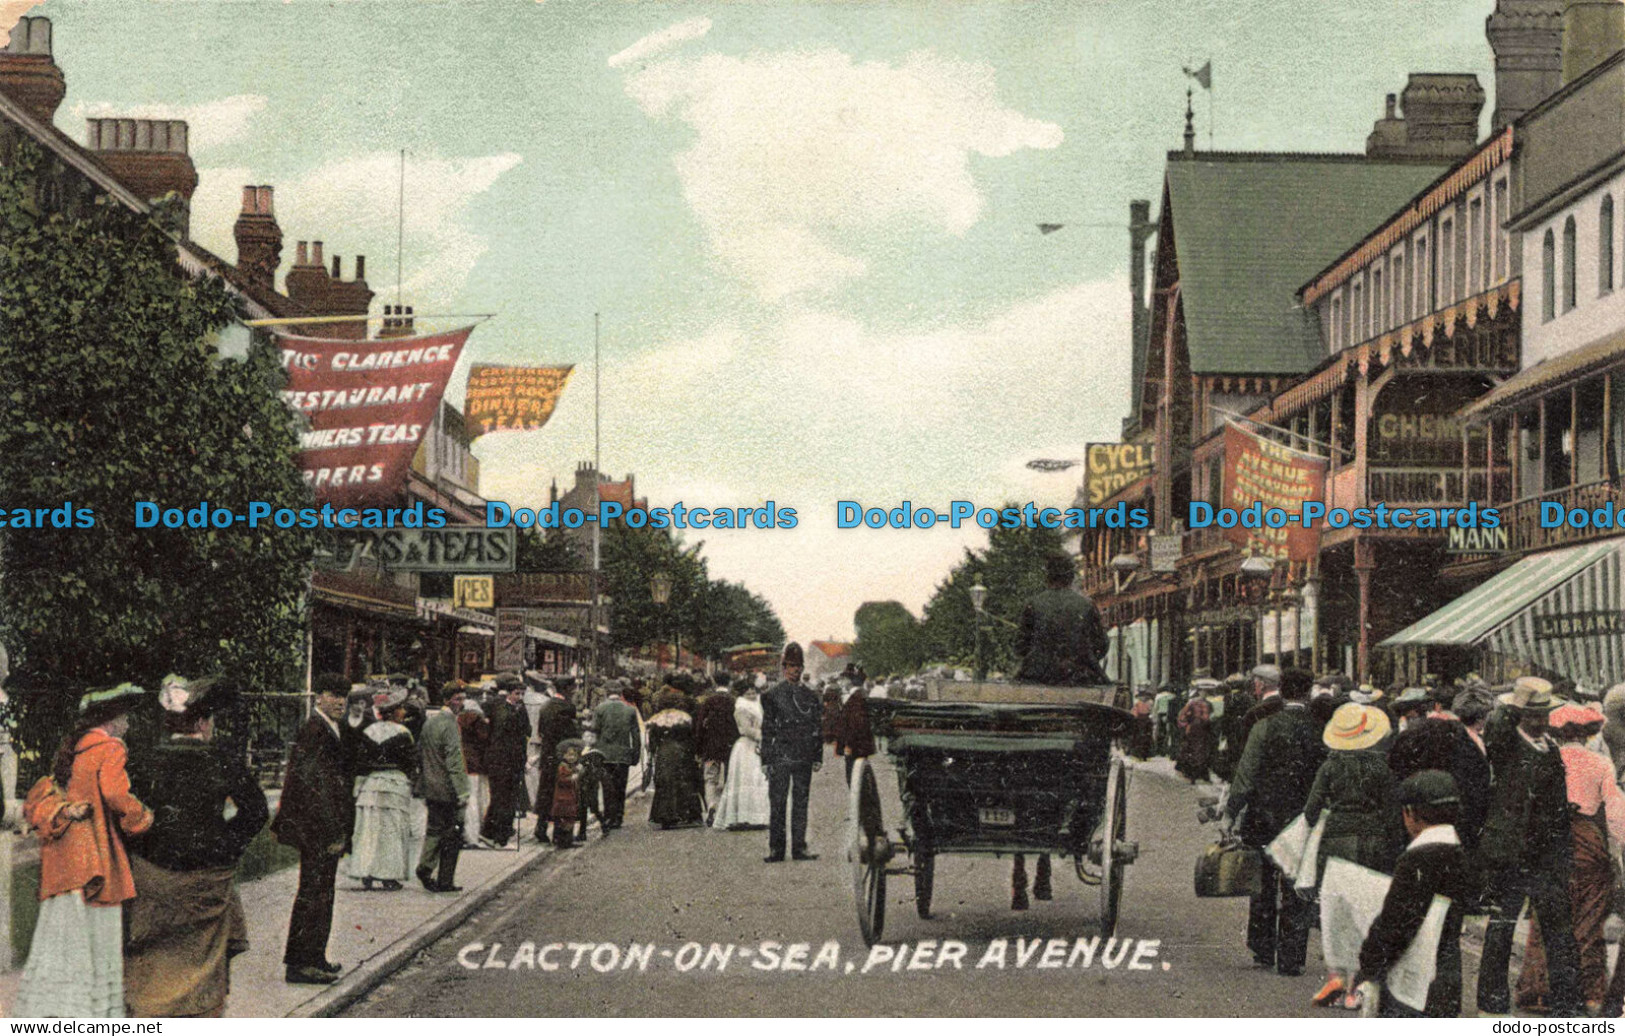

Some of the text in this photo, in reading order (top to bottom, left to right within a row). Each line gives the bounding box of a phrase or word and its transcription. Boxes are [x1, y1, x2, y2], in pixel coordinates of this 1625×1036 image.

[331, 344, 454, 372] CLARENCE
[367, 424, 423, 444] TEAS
[1258, 441, 1292, 462] THE
[302, 463, 385, 488] PPERS
[1239, 449, 1310, 483] AVENUE
[421, 531, 508, 563] TEAS
[1449, 526, 1508, 549] MANN
[457, 578, 490, 602] ICES
[1542, 614, 1617, 635] LIBRARY
